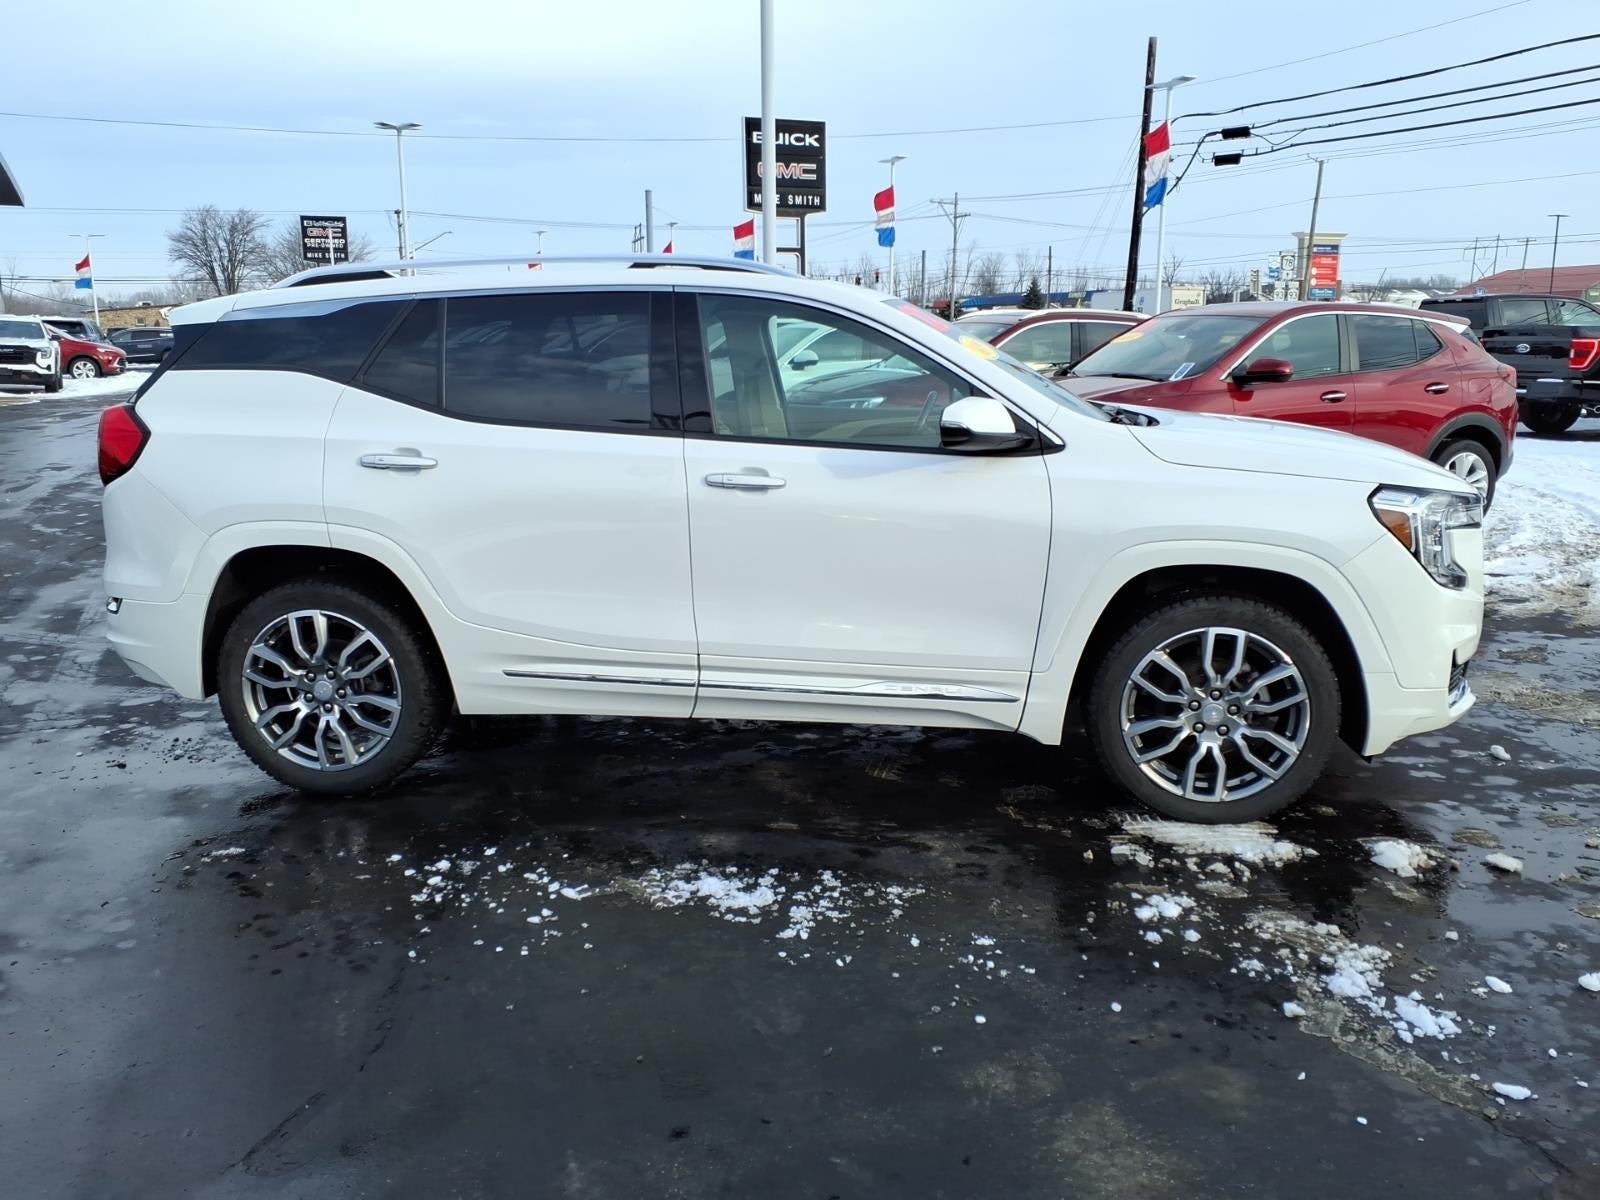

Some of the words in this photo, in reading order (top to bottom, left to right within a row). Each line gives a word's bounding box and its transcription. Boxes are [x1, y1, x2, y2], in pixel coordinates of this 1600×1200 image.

[754, 193, 780, 204] ME
[788, 195, 820, 206] SMITH
[306, 227, 342, 237] GMC
